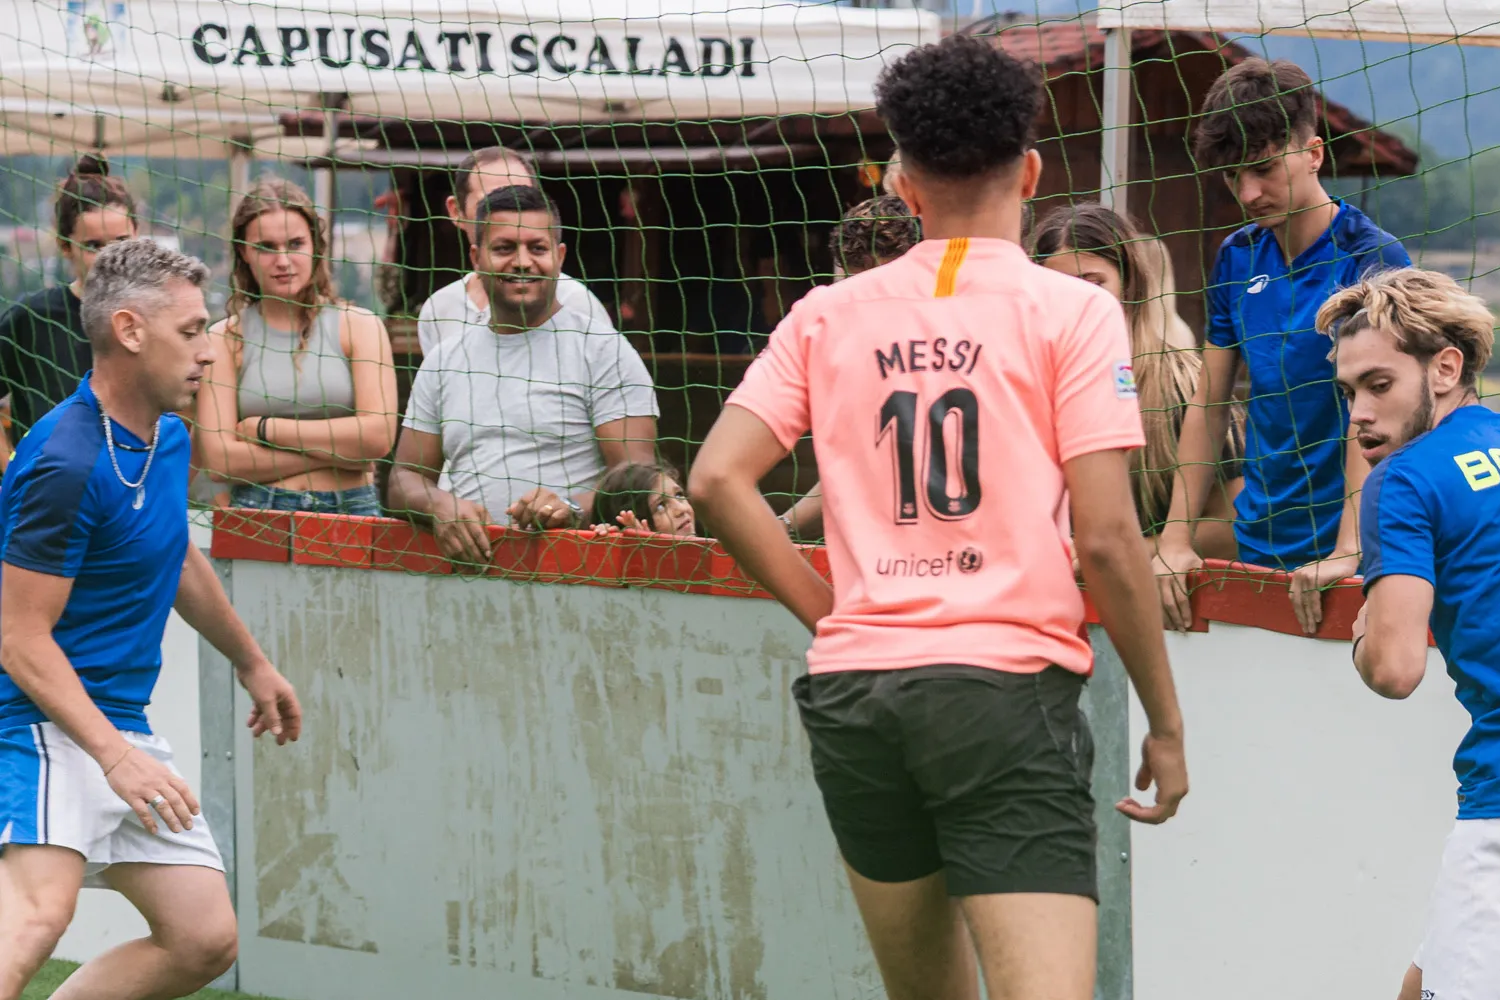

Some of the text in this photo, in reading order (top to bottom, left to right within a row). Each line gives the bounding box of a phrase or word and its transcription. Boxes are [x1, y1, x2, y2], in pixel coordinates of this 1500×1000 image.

[192, 23, 757, 77] CAPUSATI SCALADI
[875, 337, 982, 380] MESSI
[875, 387, 982, 525] 10
[877, 550, 953, 577] unicef
